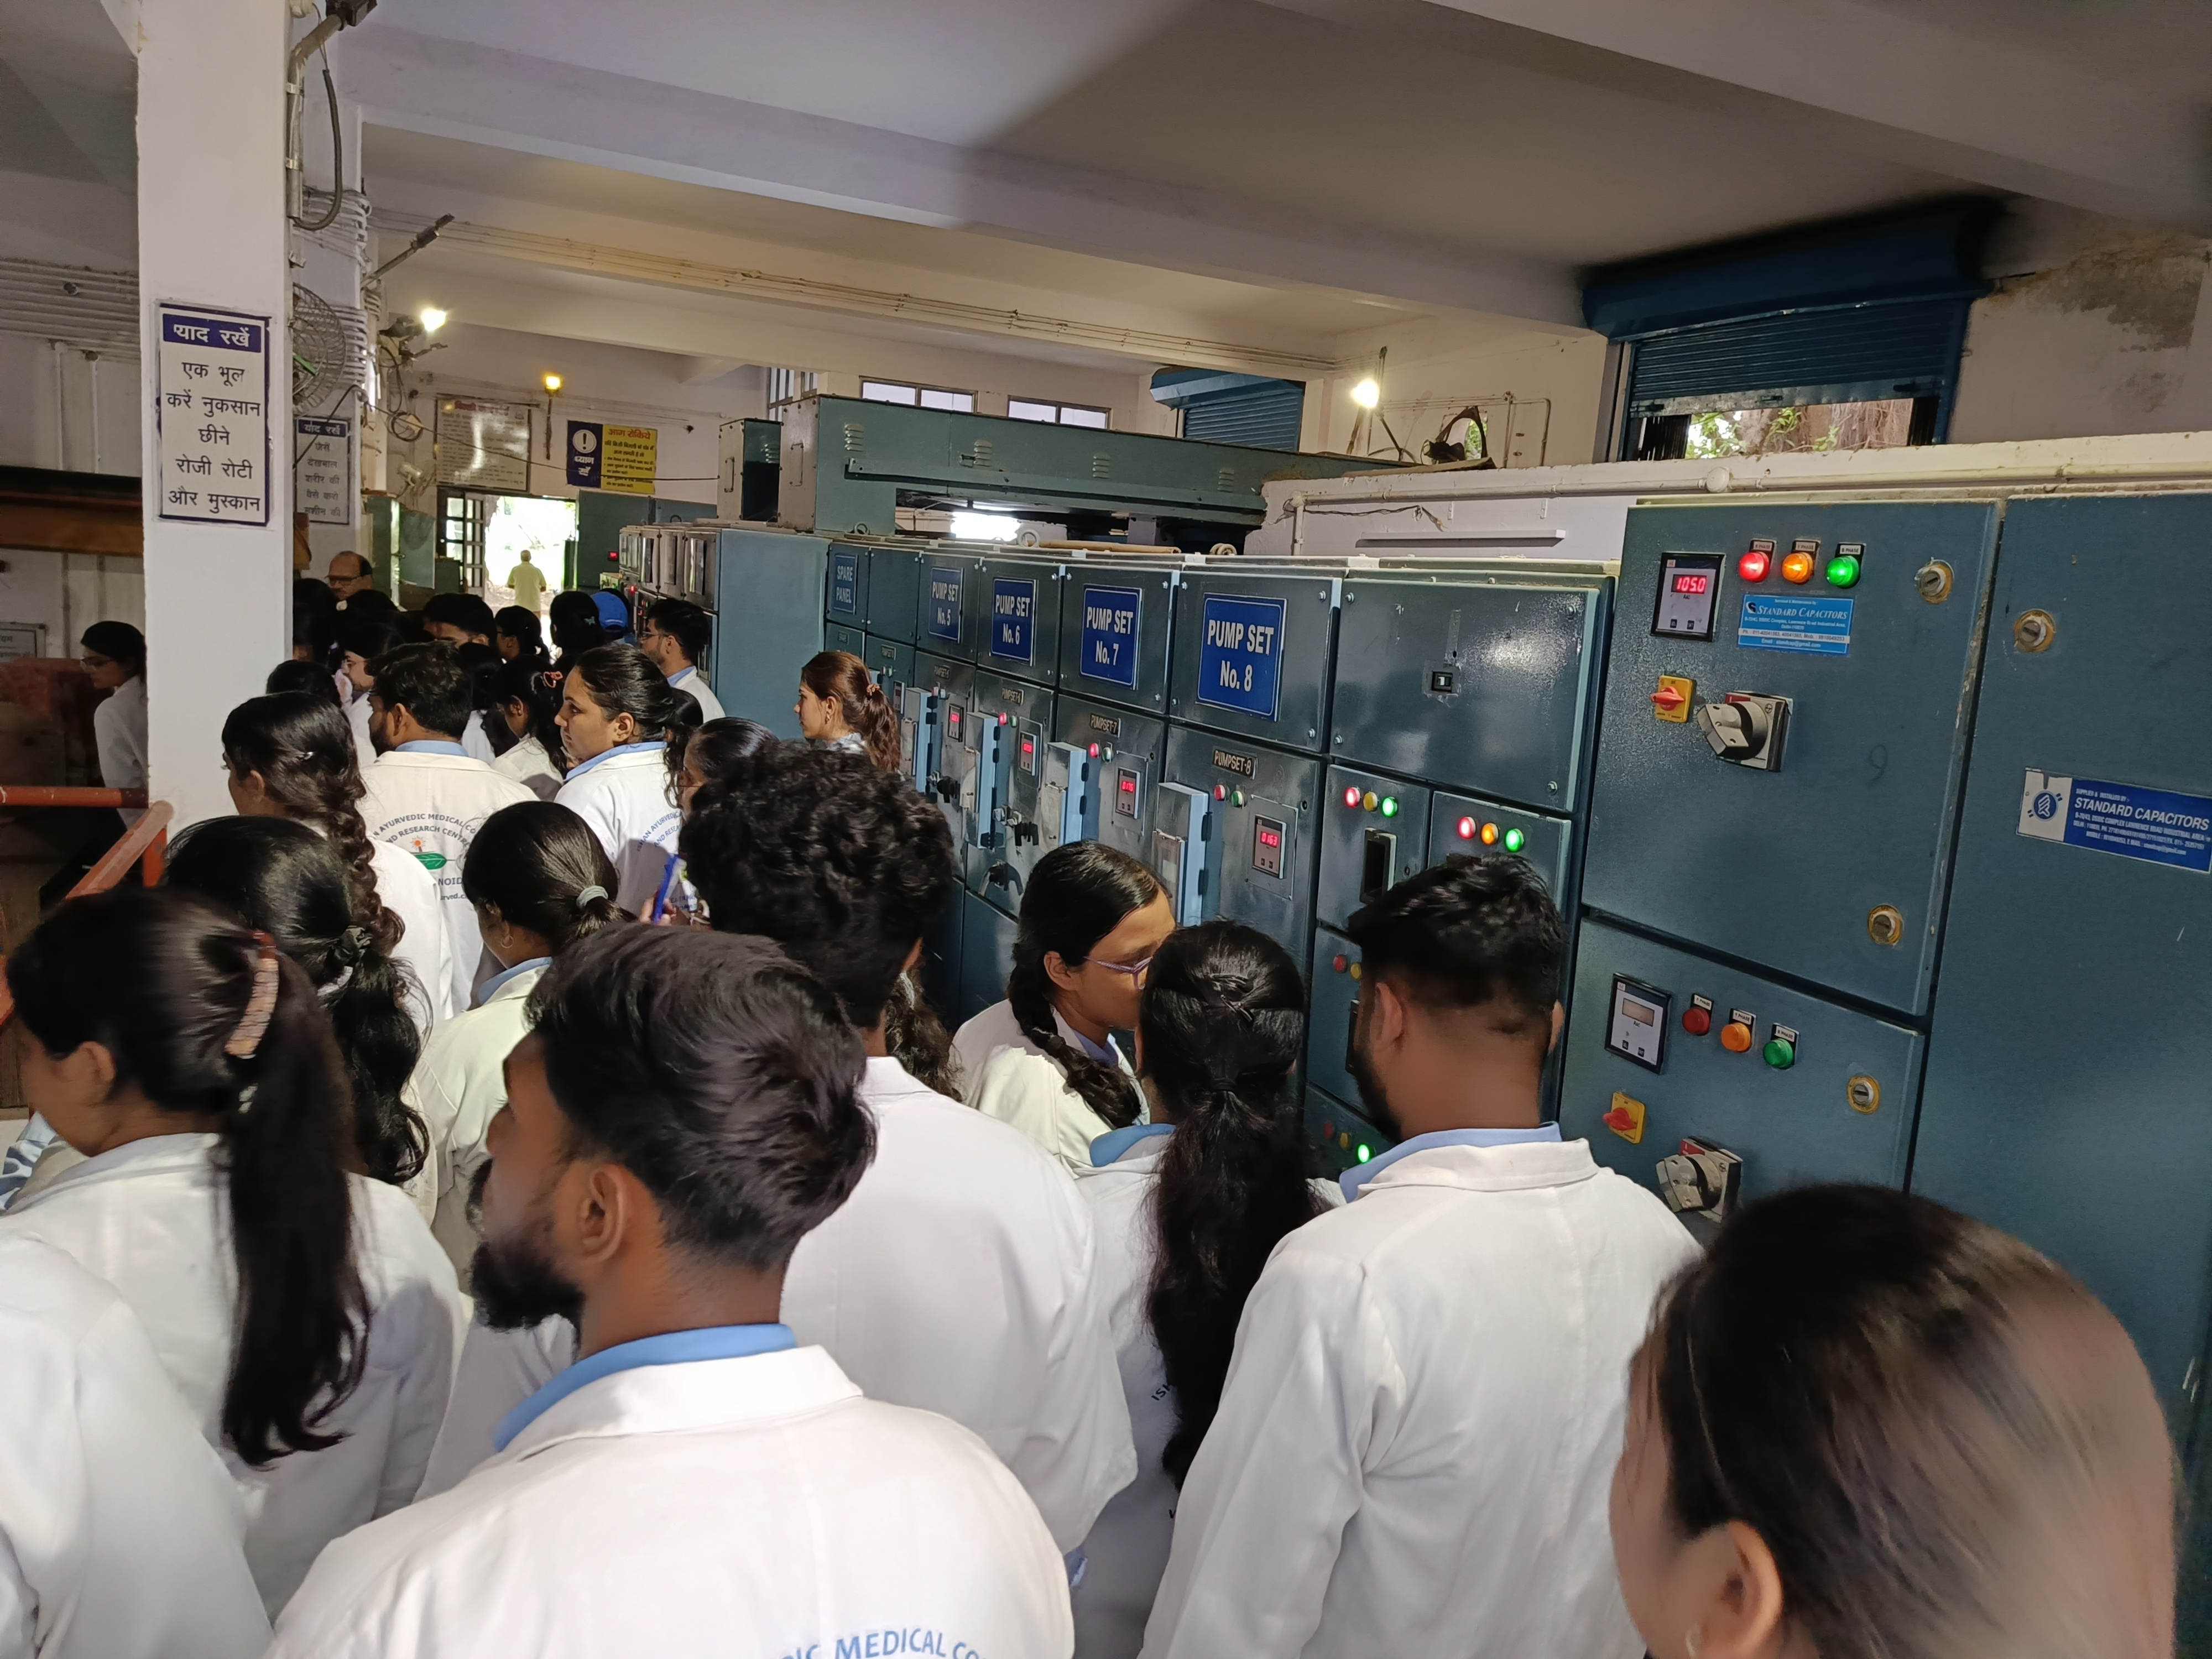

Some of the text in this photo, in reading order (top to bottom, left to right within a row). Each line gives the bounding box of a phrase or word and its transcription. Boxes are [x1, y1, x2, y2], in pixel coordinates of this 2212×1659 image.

[174, 323, 251, 347] याद रखें
[182, 362, 244, 387] एक भूल
[166, 389, 260, 417] करें नुकसान
[198, 424, 229, 445] छीने
[176, 454, 253, 479] रोजी रोटी
[169, 487, 260, 513] और मुस्कान
[837, 565, 853, 581] SPARE
[836, 587, 852, 603] PANEL
[932, 581, 959, 602] PUMP SET
[937, 607, 951, 626] No. 5
[996, 594, 1031, 618] PUMP SET
[1757, 606, 1848, 619] STANDARD CAPACITORS
[1087, 607, 1134, 635] PUMP SET
[1003, 623, 1020, 645] No. 6
[1207, 619, 1274, 656] PUMP SET
[1095, 640, 1119, 666] No. 7
[1220, 660, 1253, 692] No. 8
[1091, 714, 1117, 733] PUMPSET-7
[1214, 750, 1251, 775] PUMPSET-8
[379, 813, 476, 834] AYURVEDIC MEDICAL CO
[2075, 797, 2209, 831] STANDARD CAPACITORS
[385, 835, 398, 843] ND
[398, 826, 440, 837] RESEARCH
[637, 830, 651, 852] ISHAN
[654, 825, 680, 848] AND RESEA
[438, 877, 462, 885] NOID
[1738, 1014, 1750, 1022] PHASE
[835, 1628, 946, 1659] MEDICAL
